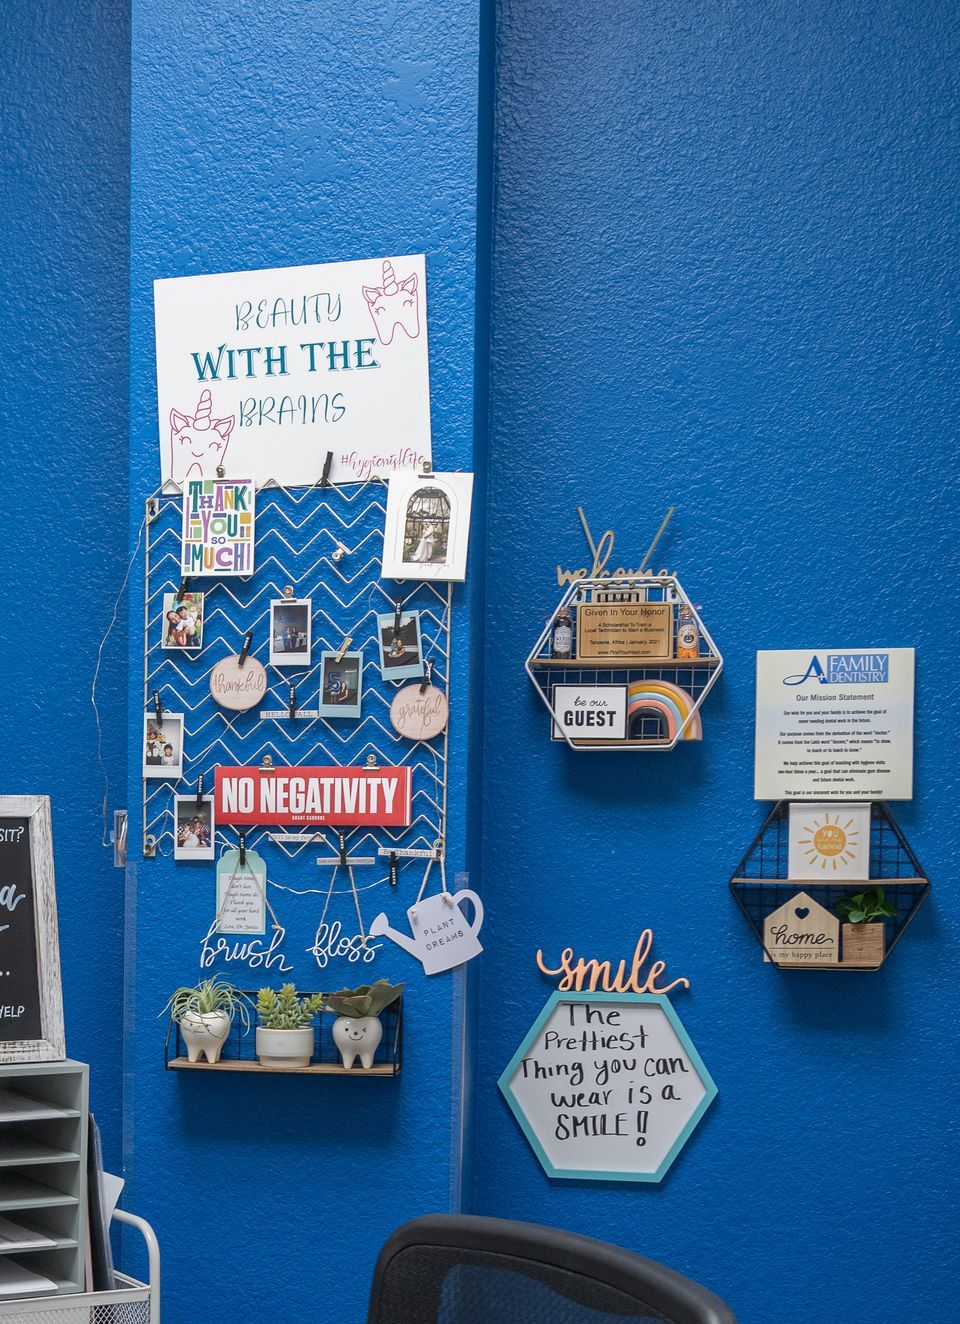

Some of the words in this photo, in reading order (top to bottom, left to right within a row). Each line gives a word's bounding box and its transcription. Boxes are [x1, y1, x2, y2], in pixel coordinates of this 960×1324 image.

[235, 292, 341, 331] BEAUTY
[190, 343, 290, 382] WITH
[299, 338, 380, 372] THE
[239, 392, 347, 427] BRAINS
[189, 481, 248, 512] THANK
[202, 510, 237, 543] YOU
[557, 530, 677, 587] welcome
[640, 608, 664, 616] Honor
[830, 655, 887, 672] FAMILY
[830, 671, 887, 683] DENTISTRY
[214, 667, 265, 696] thankful
[398, 695, 442, 728] grateful
[574, 696, 587, 707] be
[589, 698, 608, 707] our
[563, 710, 616, 727] GUEST
[222, 777, 254, 814] NO
[260, 777, 398, 815] NEGATIVITY
[0, 884, 26, 911] a
[423, 918, 455, 937] PLANT
[426, 930, 465, 951] DREAMS
[770, 924, 834, 945] home
[200, 918, 293, 972] brush
[306, 921, 383, 968] floss
[792, 951, 813, 959] happy
[815, 951, 833, 959] place
[536, 928, 690, 994] smile
[561, 1003, 621, 1027] The
[544, 1025, 649, 1052] Prettiest
[520, 1058, 584, 1086] Thing
[593, 1058, 637, 1085] you
[644, 1057, 689, 1077] can
[550, 1089, 613, 1108] wear
[628, 1081, 652, 1104] is
[661, 1084, 681, 1101] a
